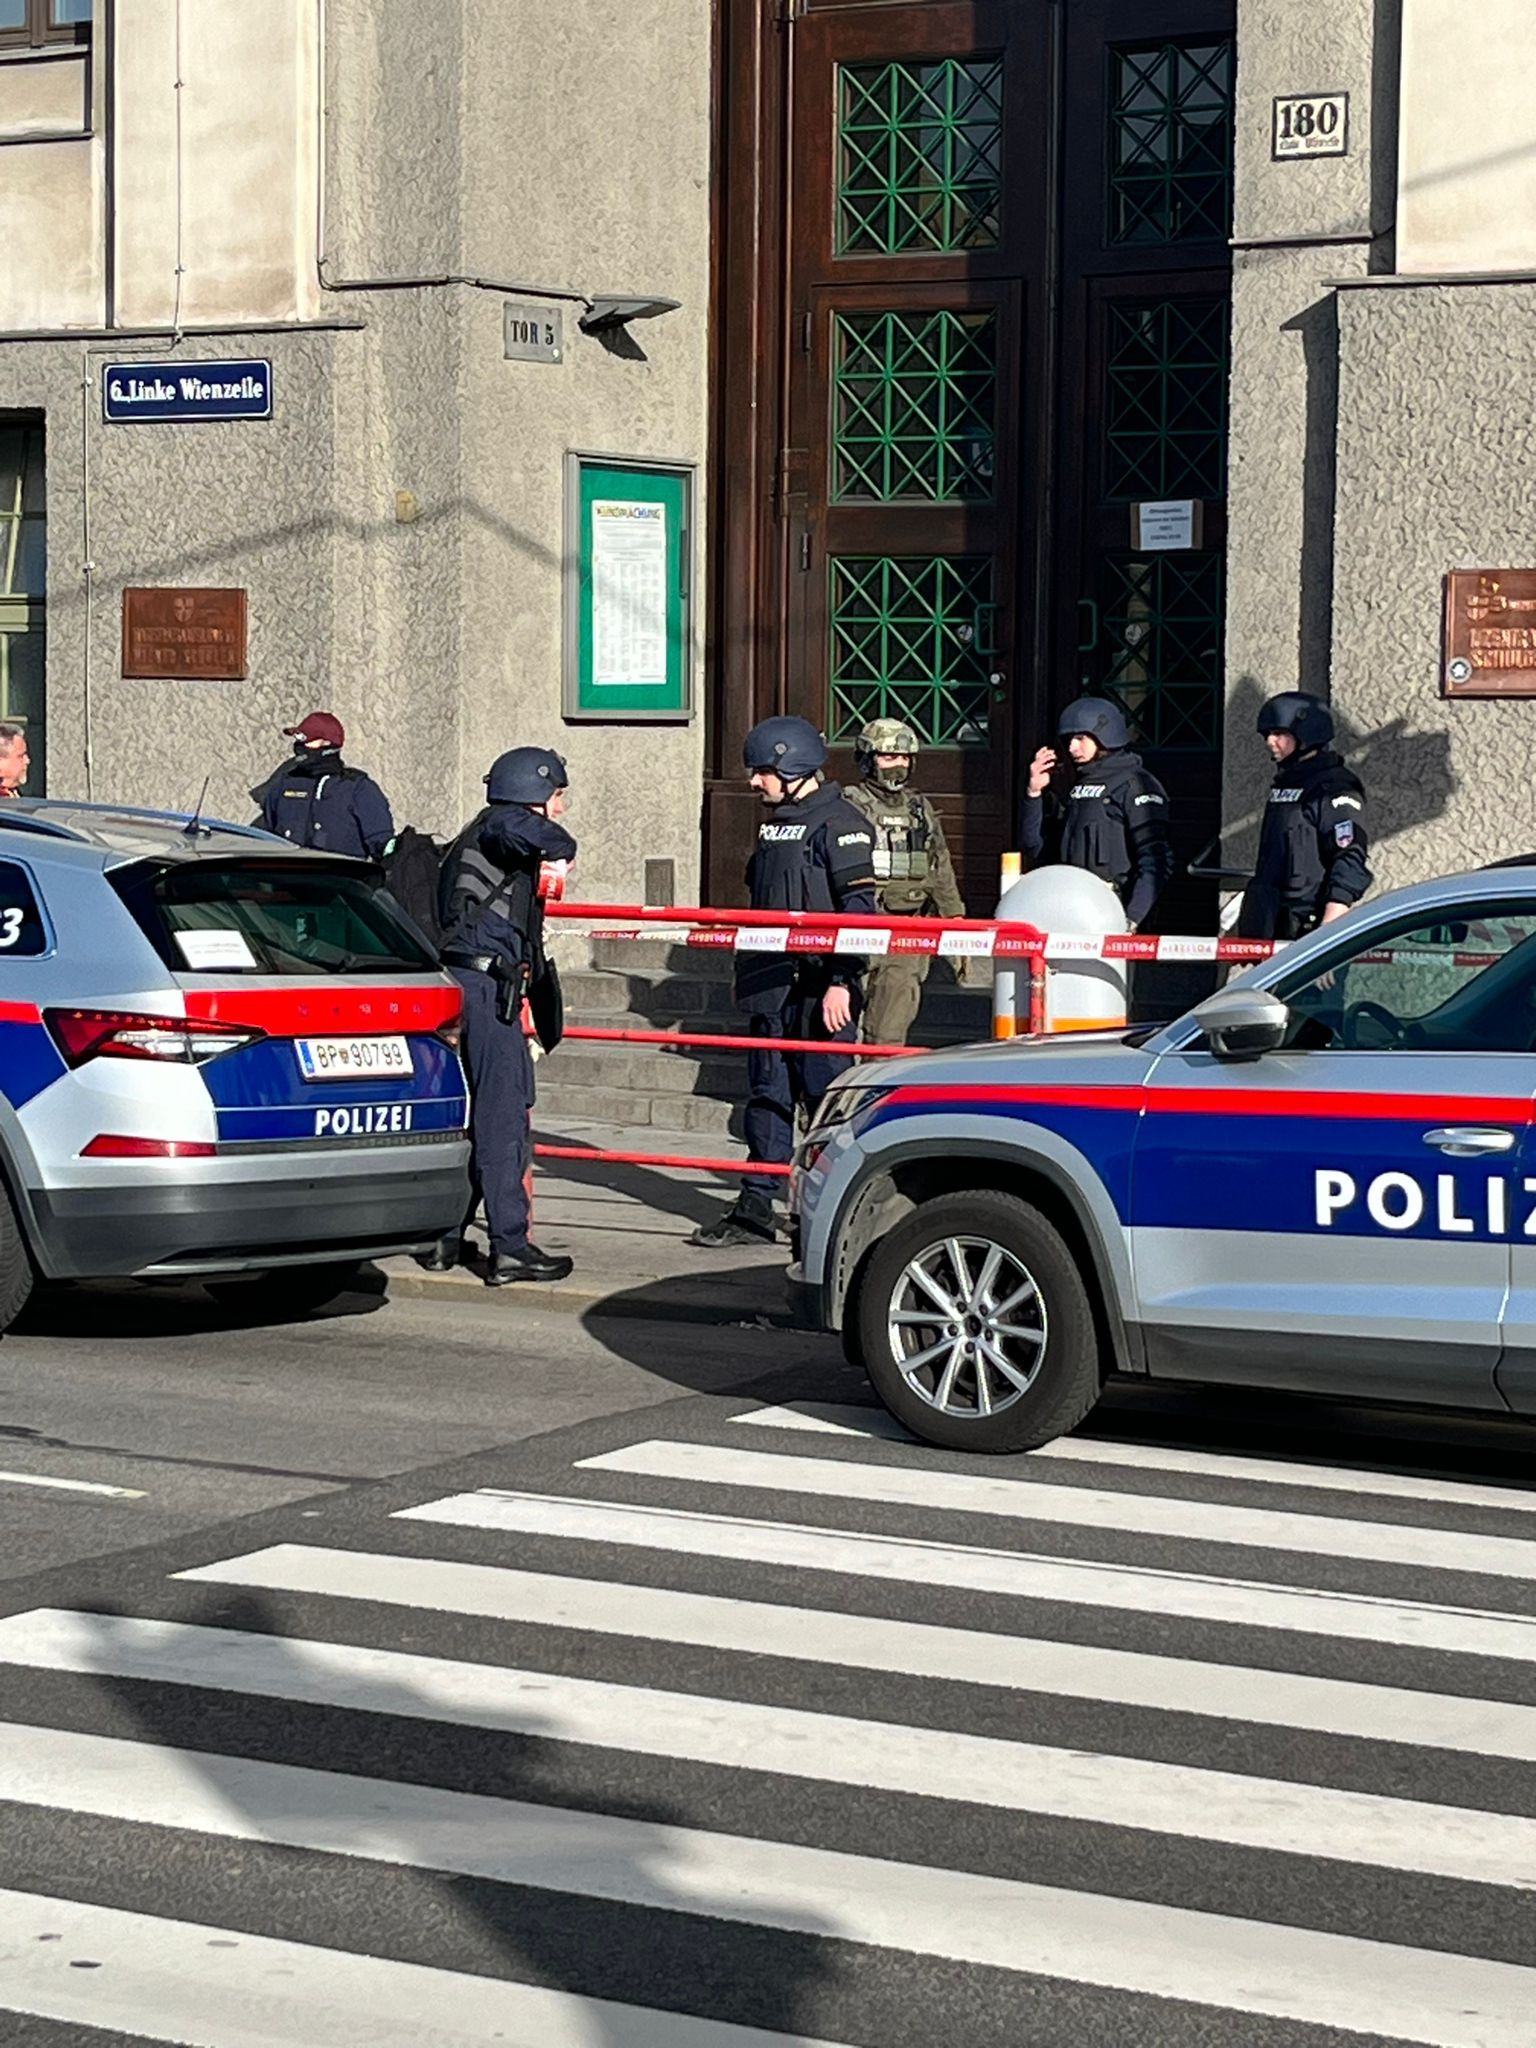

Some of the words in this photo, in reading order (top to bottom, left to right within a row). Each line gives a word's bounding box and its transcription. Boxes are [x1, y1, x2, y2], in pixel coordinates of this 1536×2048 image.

[1280, 102, 1338, 138] 180
[511, 320, 539, 344] TOR
[545, 324, 554, 345] 5
[179, 376, 264, 400] Wienzeile
[759, 823, 807, 841] POLIZEI
[0, 908, 24, 947] 3
[351, 1043, 403, 1067] 90799
[315, 1105, 412, 1136] POLIZEI
